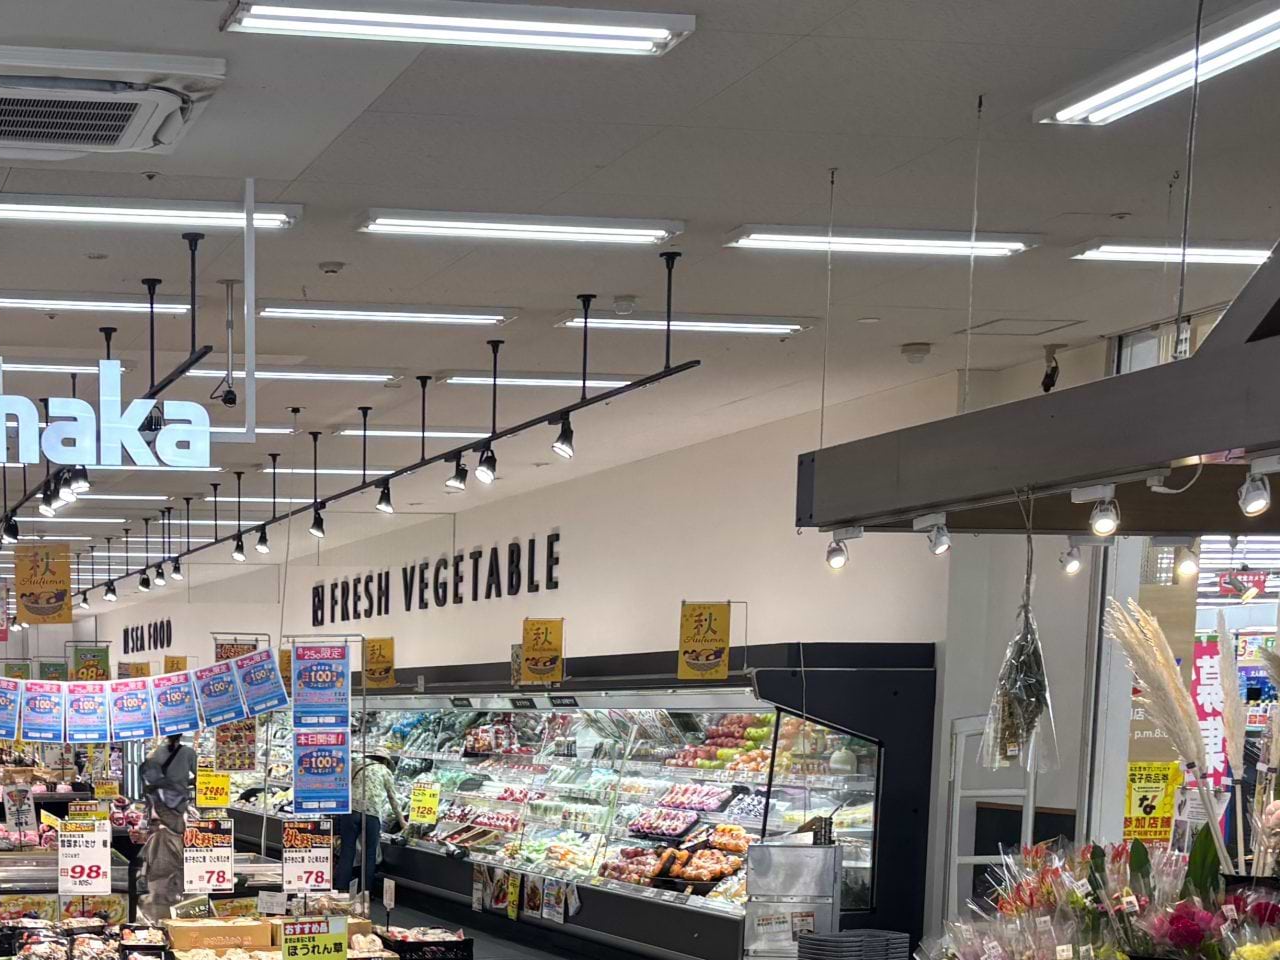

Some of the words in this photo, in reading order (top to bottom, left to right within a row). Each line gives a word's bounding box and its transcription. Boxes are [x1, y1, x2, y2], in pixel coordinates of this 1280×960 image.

[29, 550, 58, 578] 秋
[20, 575, 67, 586] Autumn
[330, 570, 390, 623] FRESH
[402, 533, 560, 612] VEGETABLE
[694, 611, 718, 636] 秋
[131, 624, 146, 653] SEA
[148, 620, 172, 651] FOOD
[533, 627, 553, 646] 秋
[310, 671, 331, 682] 100
[311, 757, 331, 768] 100
[284, 921, 329, 935] おすすめ品
[287, 942, 343, 957] ほうれん草
